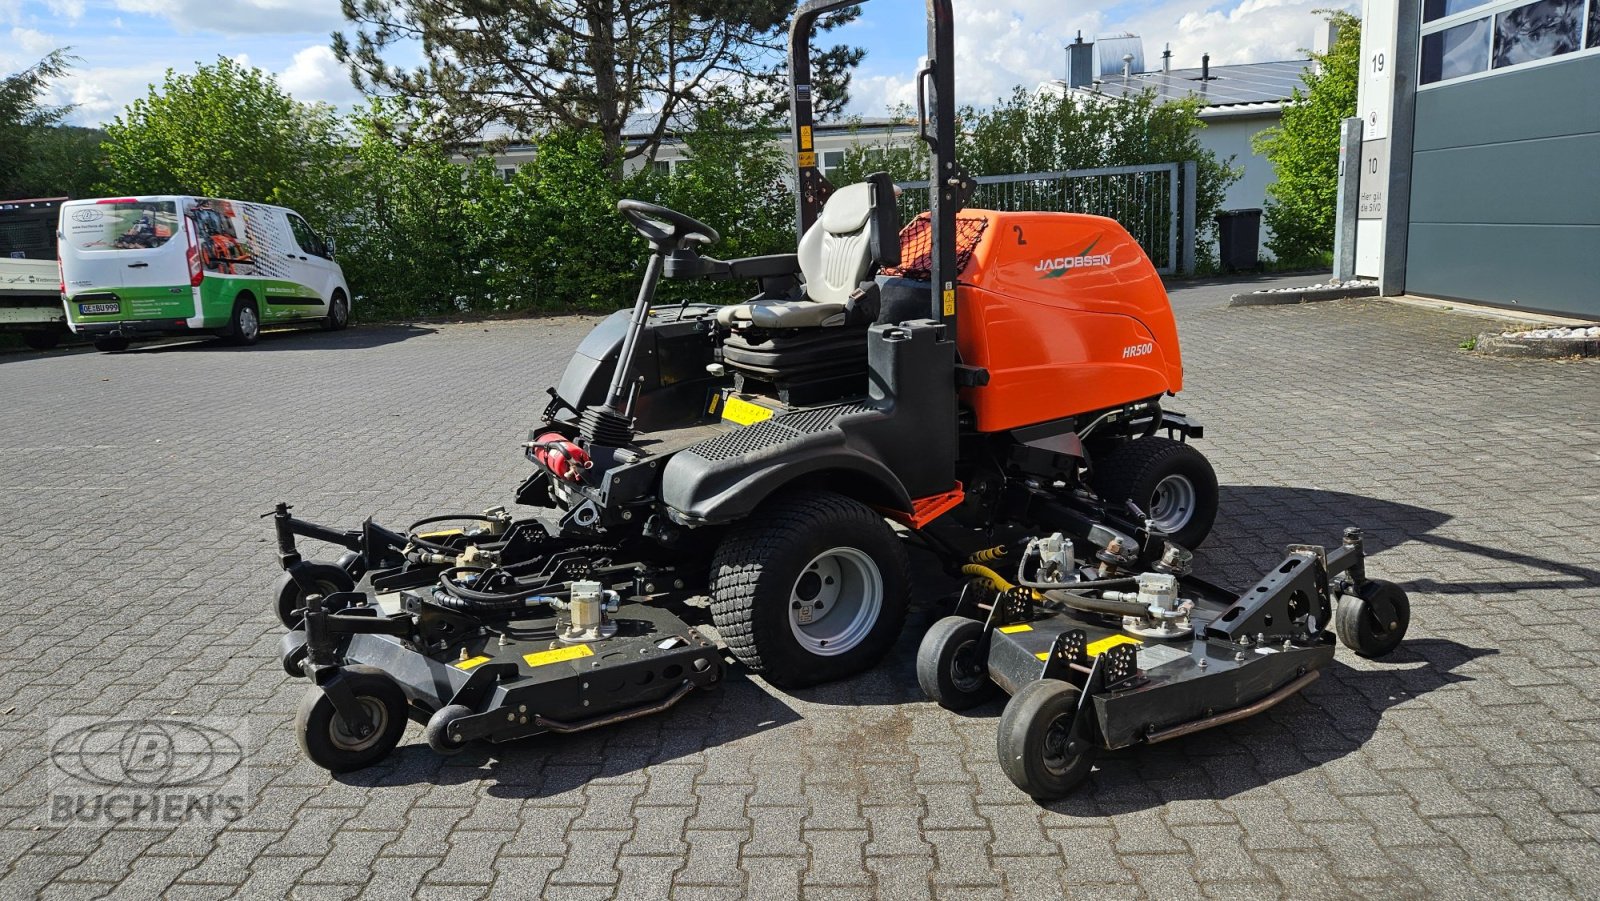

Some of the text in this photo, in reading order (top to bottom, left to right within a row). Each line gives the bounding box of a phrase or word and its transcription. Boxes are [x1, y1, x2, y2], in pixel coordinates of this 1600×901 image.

[1372, 53, 1385, 73] 19
[1368, 157, 1378, 174] 10
[1013, 225, 1027, 245] 2
[1034, 254, 1112, 272] JACOBSEN
[83, 303, 118, 313] OE BU 999
[1122, 342, 1153, 359] HR500
